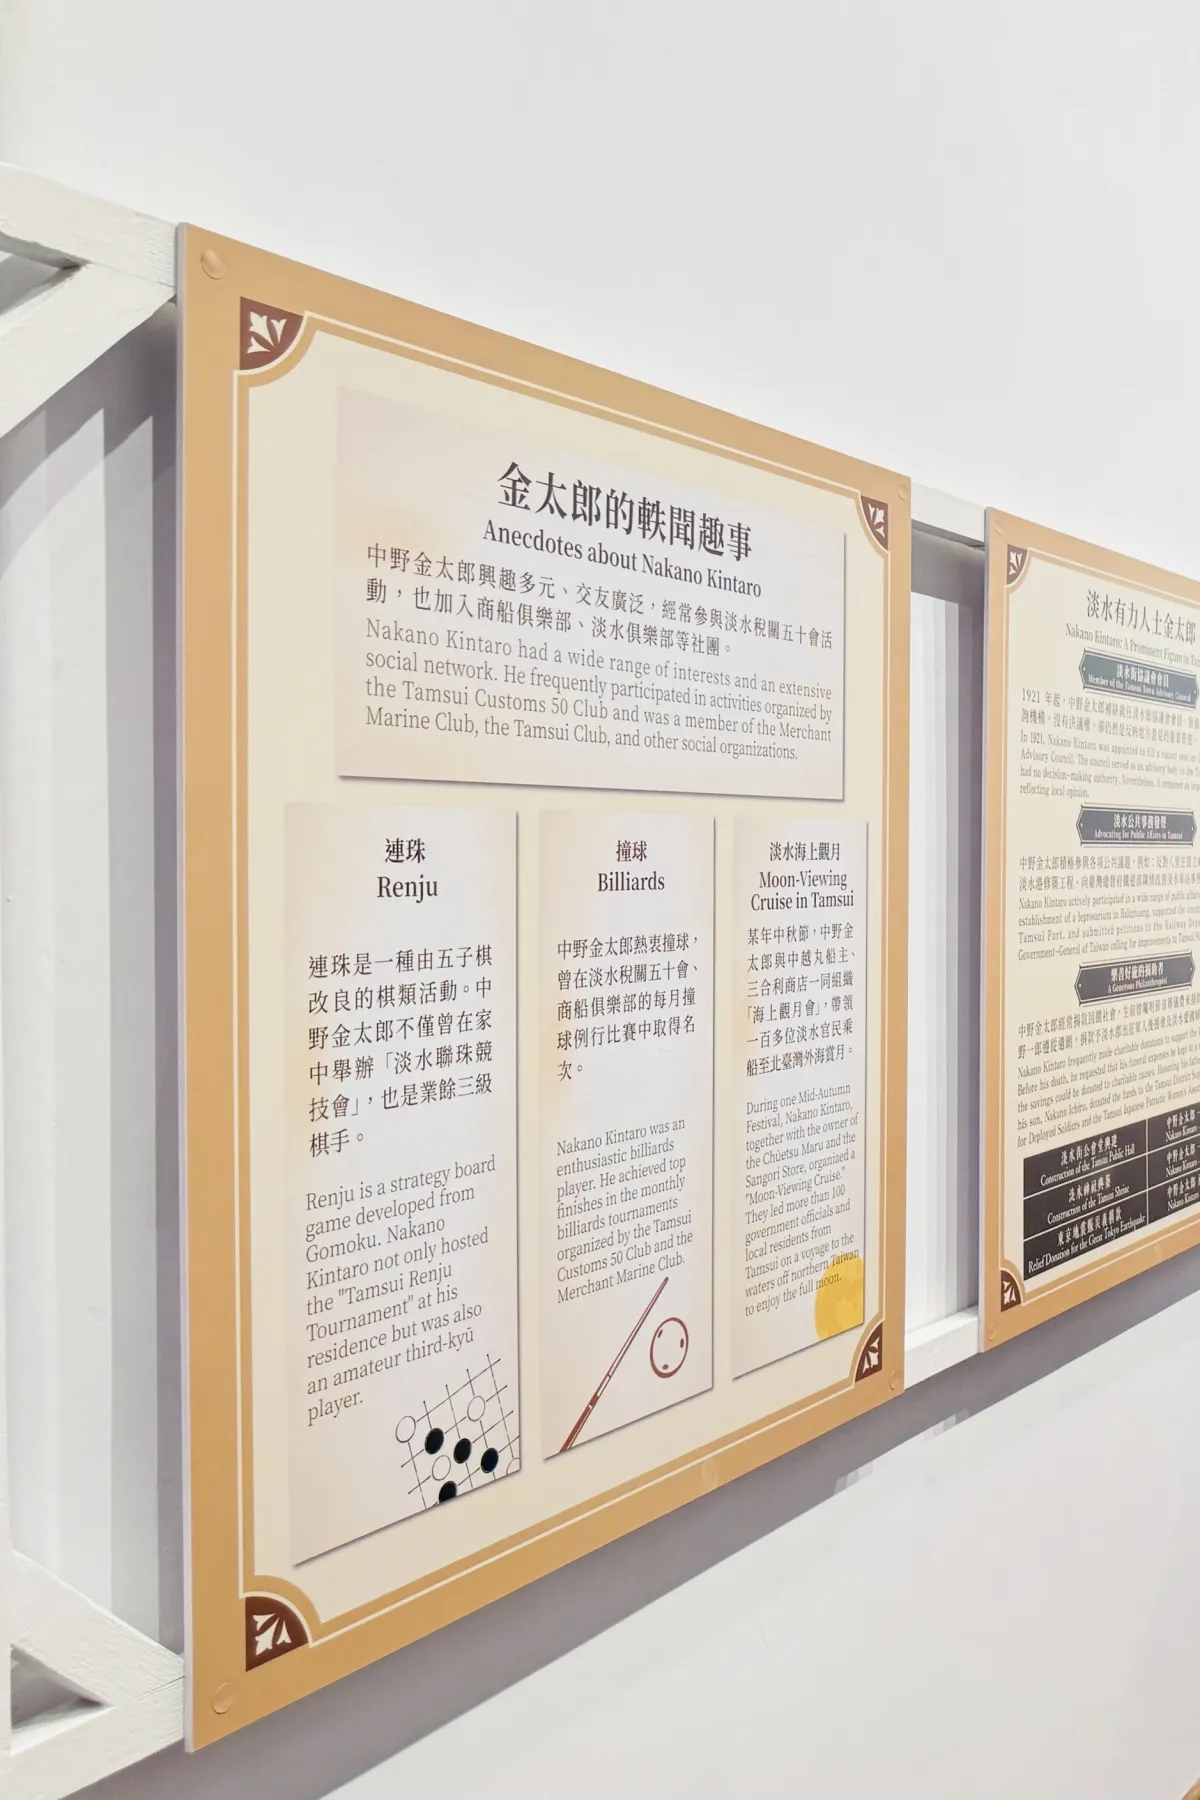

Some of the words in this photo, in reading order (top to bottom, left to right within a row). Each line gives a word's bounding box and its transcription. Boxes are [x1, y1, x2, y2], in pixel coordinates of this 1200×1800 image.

[496, 460, 752, 562] 金太郎的軼聞趣事
[482, 518, 583, 560] Anecdotes
[586, 541, 637, 572] about
[641, 552, 703, 585] Nakano
[706, 567, 762, 598] Kintaro
[1085, 588, 1196, 646] 淡水有力人士金太郎
[365, 616, 439, 647] Nakano
[445, 628, 513, 657] Kintaro
[517, 637, 549, 662] had
[552, 648, 563, 664] a
[566, 647, 605, 670] wide
[609, 656, 651, 680] range
[654, 659, 669, 678] of
[673, 661, 731, 687] interests
[733, 672, 758, 691] and
[759, 678, 776, 693] an
[778, 681, 832, 700] extensive
[365, 649, 418, 673] social
[423, 652, 498, 682] network.
[503, 663, 526, 685] He
[529, 665, 607, 700] frequently
[610, 680, 691, 706] participated
[693, 687, 707, 707] in
[708, 692, 762, 713] activities
[763, 700, 817, 720] organized
[818, 703, 833, 726] by
[364, 674, 397, 699] the
[401, 679, 469, 706] Tamsui
[474, 687, 547, 714] Customs
[550, 696, 569, 716] 50
[572, 697, 609, 720] Club
[611, 703, 640, 723] and
[643, 710, 669, 726] was
[672, 713, 681, 727] a
[684, 710, 739, 733] member
[740, 716, 755, 734] of
[756, 717, 776, 737] the
[778, 720, 832, 742] Merchant
[365, 704, 430, 730] Marine
[434, 710, 479, 738] Club,
[483, 714, 510, 737] the
[512, 718, 569, 742] Tamsui
[572, 722, 611, 748] Club,
[614, 727, 641, 747] and
[642, 729, 677, 750] other
[681, 734, 717, 753] social
[718, 739, 798, 760] organizations.
[384, 836, 426, 864] 連珠
[615, 838, 648, 863] 撞球
[768, 840, 840, 862] 淡水海上觀月
[376, 873, 438, 904] Renju
[597, 869, 665, 892] Billiards
[758, 868, 848, 890] Moon-Viewing
[749, 891, 793, 912] Cruise
[795, 890, 808, 909] in
[809, 888, 854, 908] Tamsui
[556, 931, 698, 961] 中野金太郎熱衷撞球，
[746, 920, 854, 946] 某年中秋節，中野金
[307, 943, 492, 979] 連珠是一種由五子棋
[557, 958, 698, 991] 曾在淡水稅關五十會、
[746, 945, 855, 973] 太郎與中越丸船主、
[307, 975, 492, 1015] 改良的棋類活動。中
[557, 985, 696, 1022] 商船俱樂部的每月撞
[746, 969, 854, 998] 三合利商店一同組織
[308, 1007, 492, 1051] 野金太郎不僅曾在家
[555, 1013, 695, 1052] 球例行比賽中取得名
[746, 1016, 853, 1049] 一百多位淡水官民乘
[555, 1058, 584, 1083] 次。
[745, 1042, 853, 1077] 船至北臺灣外海賞月。
[745, 1097, 779, 1116] During
[778, 1094, 797, 1108] one
[797, 1083, 851, 1105] Mid-Autumn
[745, 1111, 783, 1134] Festival,
[784, 1107, 819, 1125] Nakano
[819, 1100, 853, 1117] Kintaro,
[308, 1127, 364, 1159] 棋手。
[555, 1135, 603, 1157] Nakano
[604, 1126, 647, 1146] Kintaro
[648, 1121, 670, 1136] was
[671, 1118, 685, 1132] an
[555, 1147, 628, 1178] enthusiastic
[629, 1136, 675, 1161] billiards
[305, 1184, 355, 1211] Renju
[359, 1180, 373, 1200] is
[376, 1181, 386, 1196] a
[389, 1167, 451, 1193] strategy
[454, 1153, 496, 1180] board
[556, 1178, 596, 1203] player.
[598, 1170, 616, 1188] He
[617, 1156, 667, 1184] achieved
[668, 1156, 686, 1173] top
[556, 1196, 603, 1220] finishes
[604, 1190, 617, 1207] in
[619, 1185, 639, 1203] the
[639, 1172, 686, 1198] monthly
[304, 1214, 352, 1243] game
[354, 1189, 436, 1226] developed
[439, 1186, 475, 1207] from
[556, 1213, 606, 1241] billiards
[607, 1196, 678, 1227] tournaments
[305, 1231, 382, 1263] Gomoku.
[386, 1217, 446, 1244] Nakano
[555, 1229, 615, 1263] organized
[616, 1227, 631, 1247] by
[632, 1221, 651, 1240] the
[651, 1208, 692, 1234] Tamsui
[305, 1261, 369, 1290] Kintaro
[373, 1251, 400, 1273] not
[402, 1240, 437, 1265] only
[440, 1224, 489, 1255] hosted
[556, 1256, 608, 1283] Customs
[609, 1249, 624, 1267] 50
[624, 1240, 652, 1262] Club
[653, 1232, 675, 1254] and
[675, 1229, 694, 1247] the
[305, 1294, 334, 1316] the
[407, 1261, 453, 1288] Renju
[416, 1291, 432, 1310] at
[435, 1283, 459, 1305] his
[556, 1274, 614, 1304] Merchant
[615, 1262, 656, 1285] Marine
[656, 1250, 686, 1272] Club.
[306, 1331, 388, 1369] residence
[390, 1320, 417, 1343] but
[420, 1312, 450, 1333] was
[452, 1302, 482, 1324] also
[306, 1376, 329, 1395] an
[332, 1353, 399, 1387] amateur
[307, 1384, 363, 1427] player.
